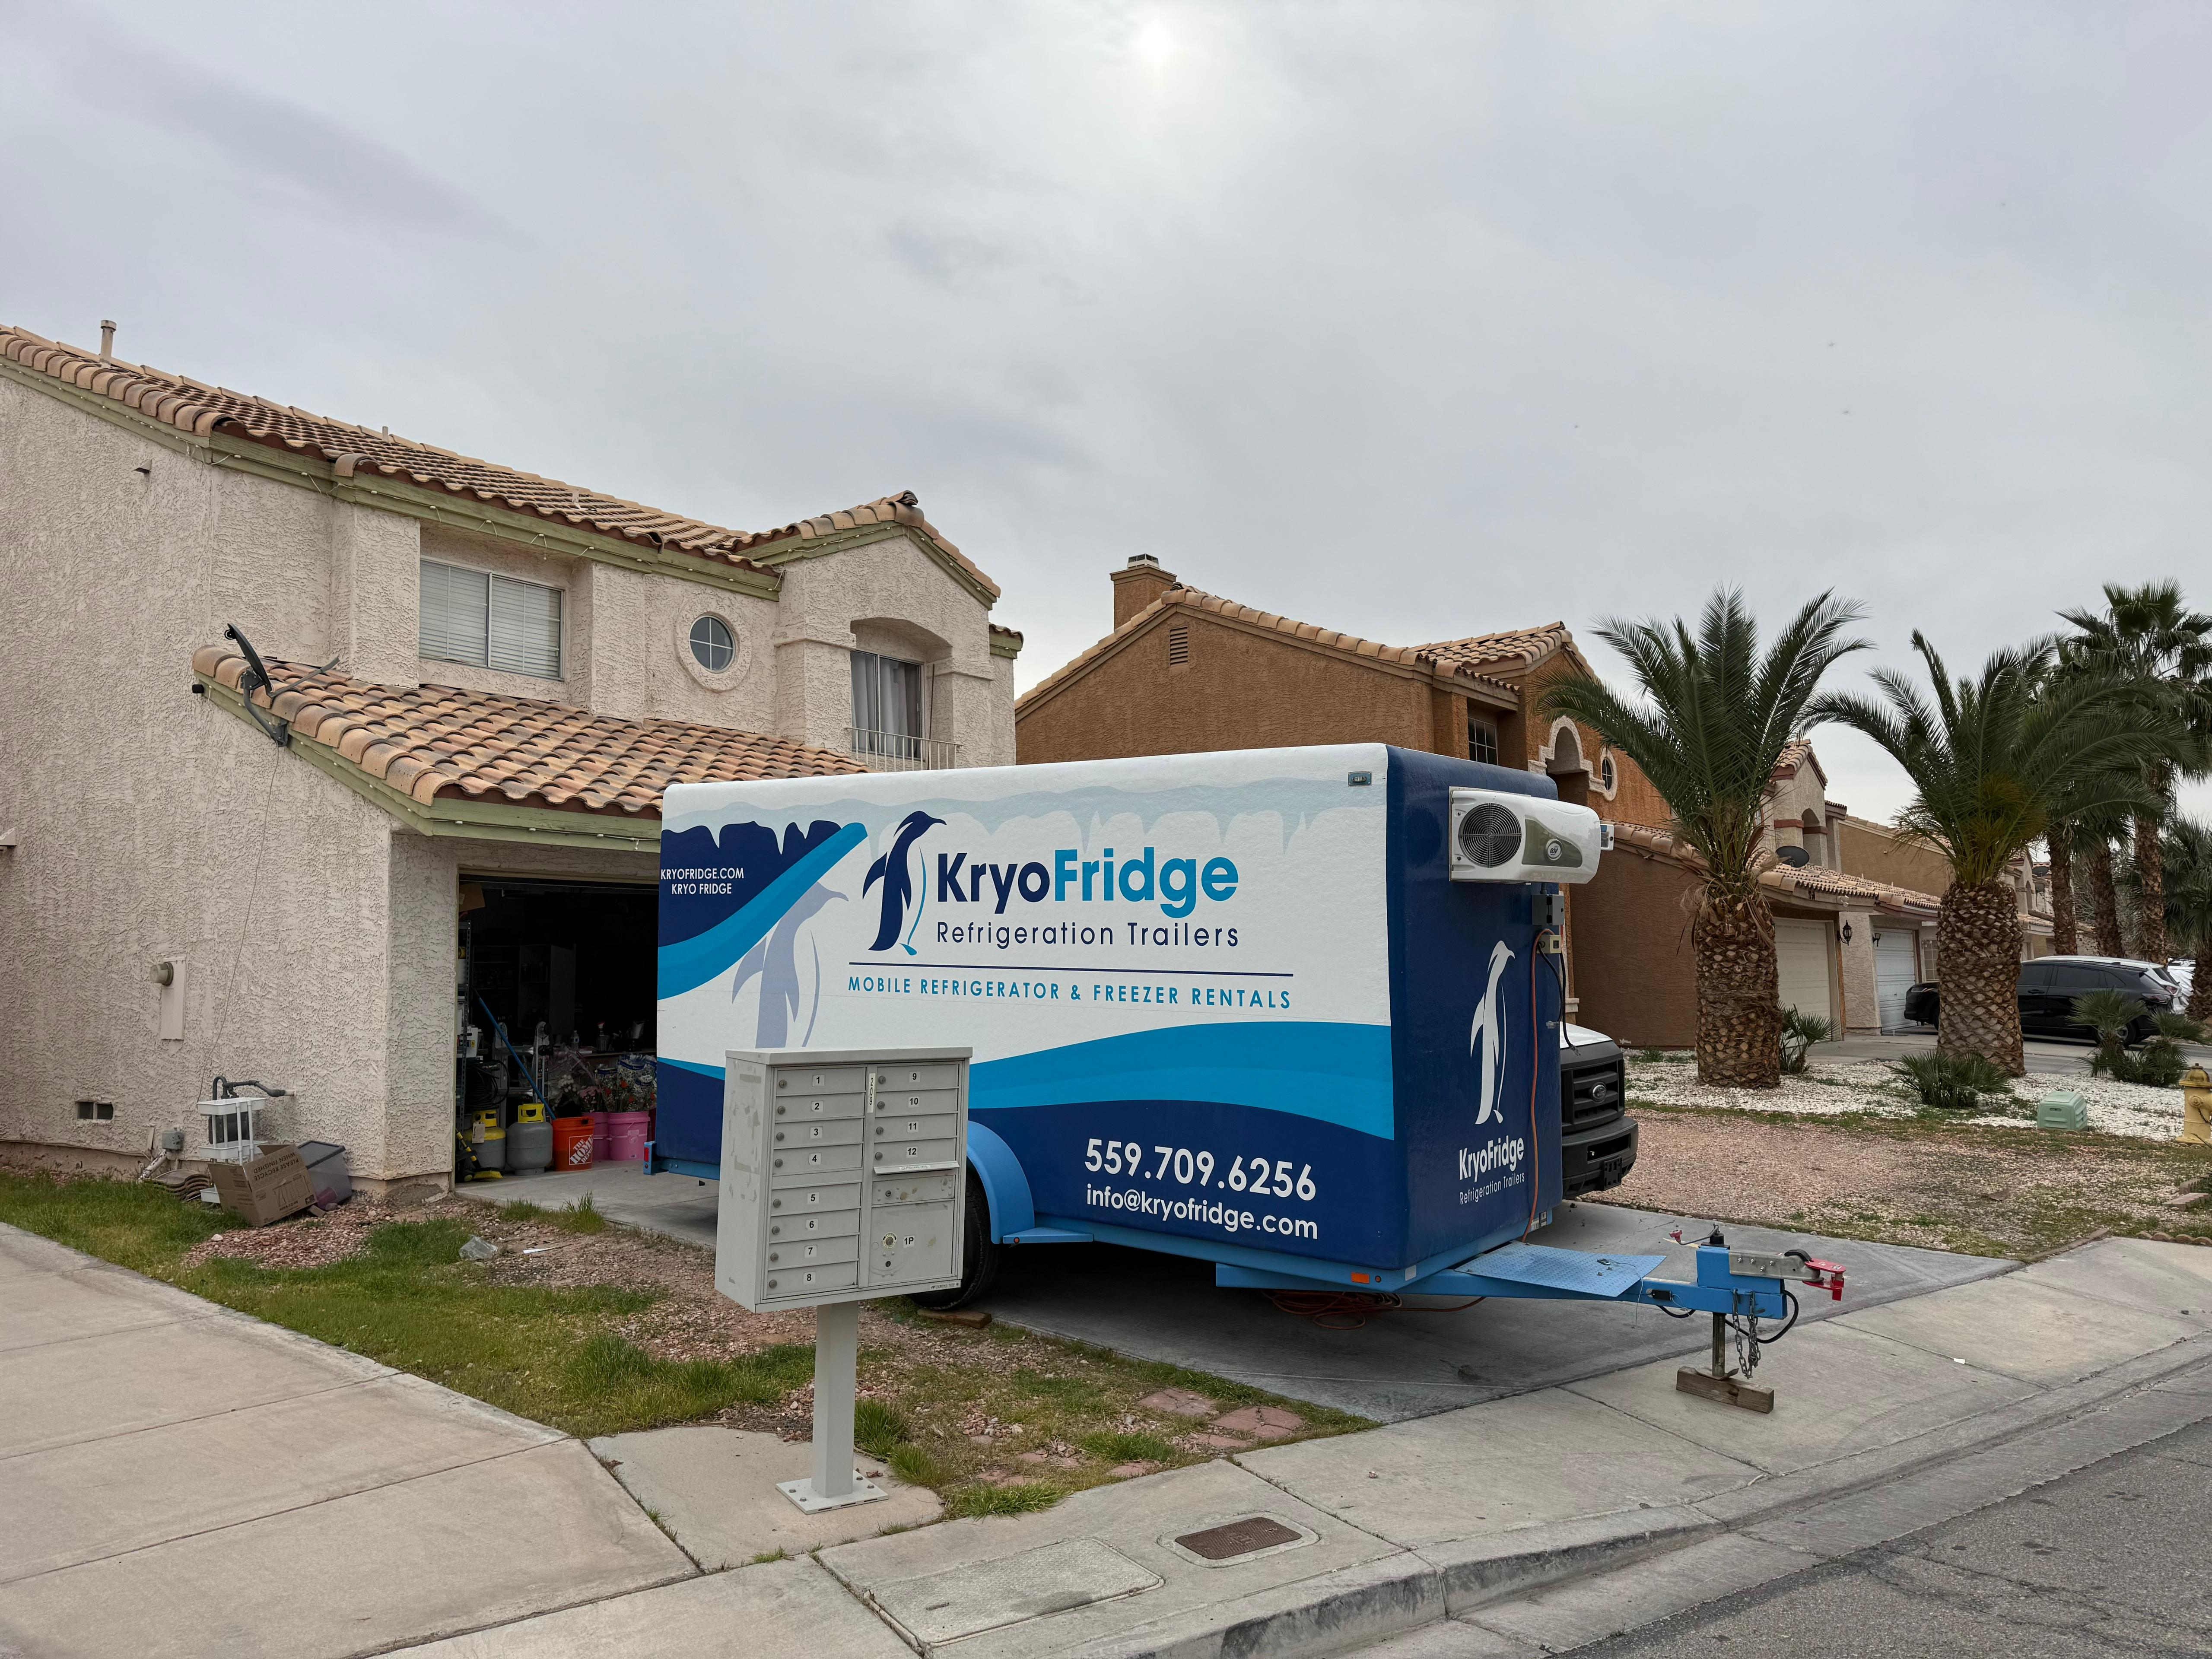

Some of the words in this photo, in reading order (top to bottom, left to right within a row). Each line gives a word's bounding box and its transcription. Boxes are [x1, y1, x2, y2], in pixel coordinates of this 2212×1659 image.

[661, 868, 744, 880] KRYOFRIDGE.COM
[938, 846, 1239, 918] KryoFridge
[671, 884, 696, 895] KRYO
[699, 883, 732, 894] FRIDGE
[937, 922, 1113, 950] Refrigeration
[1127, 922, 1238, 947] Trailers
[848, 976, 910, 993] MOBILE
[921, 979, 1059, 999] REFRIGERATOR
[1071, 985, 1081, 1000] &
[1094, 985, 1178, 1004] FREEZER
[1192, 988, 1290, 1009] RENTALS
[254, 1160, 277, 1173] FINISHED
[279, 1152, 296, 1163] WHEN
[280, 1158, 299, 1170] PLEASE
[1084, 1138, 1316, 1201] 559.709.6256
[1459, 1135, 1524, 1182] KryoFridge
[254, 1166, 279, 1181] RECYCLE
[1460, 1180, 1501, 1205] Refrigeration
[1503, 1172, 1525, 1189] Trailers
[1087, 1183, 1318, 1239] info@kryofridge.com
